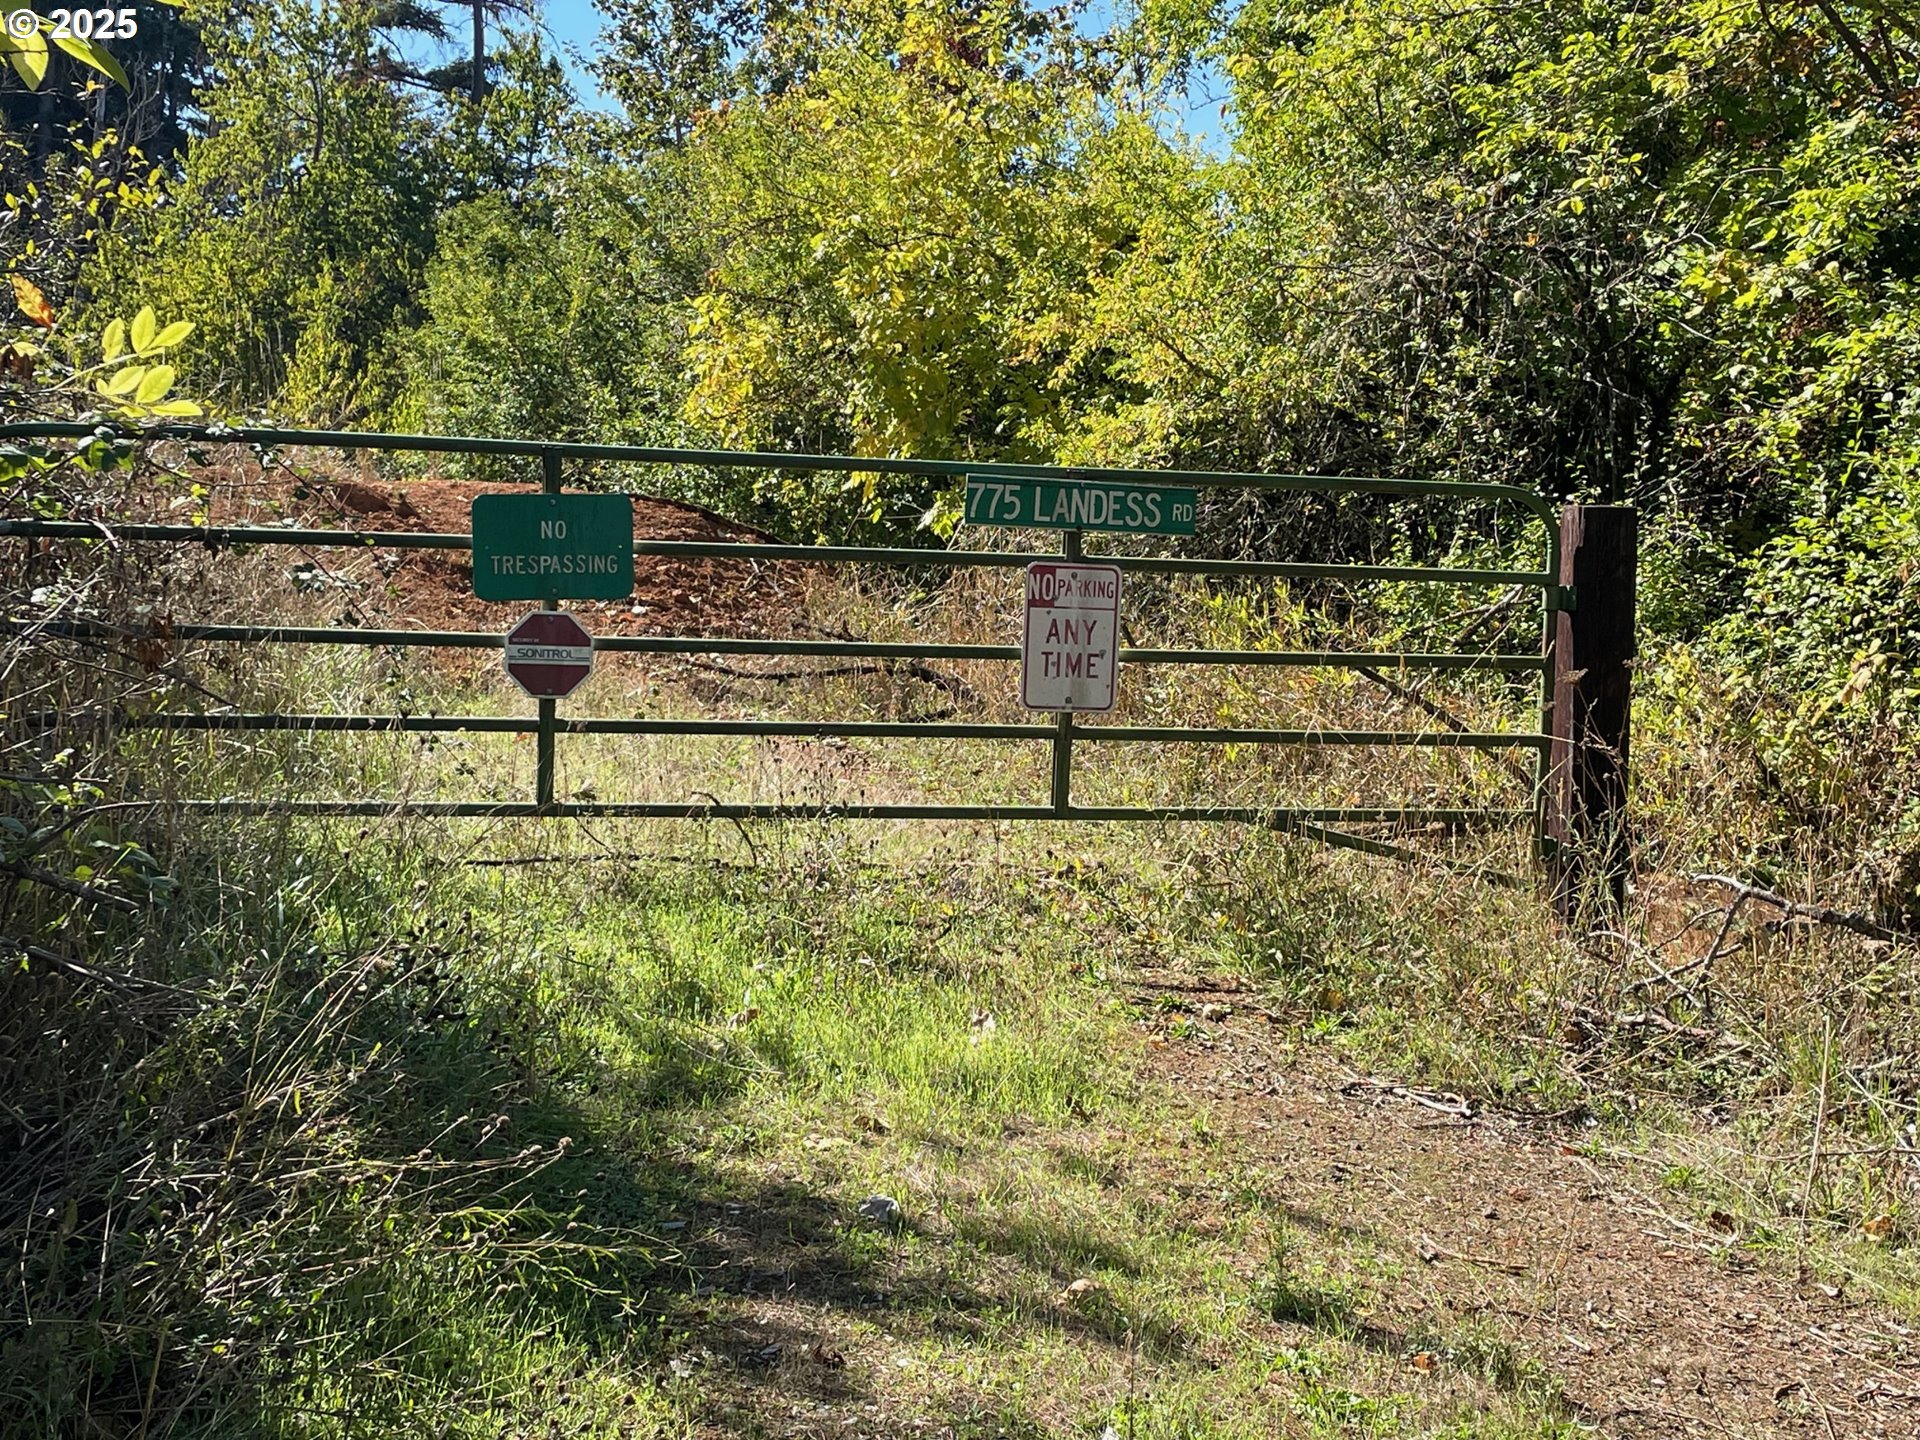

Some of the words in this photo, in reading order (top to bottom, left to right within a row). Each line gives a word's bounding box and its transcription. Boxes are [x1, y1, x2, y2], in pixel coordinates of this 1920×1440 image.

[967, 482, 1021, 521] 775
[1033, 486, 1162, 528] LANDESS
[1172, 503, 1193, 523] RD
[540, 520, 567, 540] NO
[491, 555, 618, 575] TRESPASSING
[1028, 573, 1055, 601] NO
[1056, 579, 1115, 599] PARKING
[1045, 618, 1098, 646] ANY
[517, 647, 575, 659] SONITROL
[1041, 651, 1100, 679] TIME
